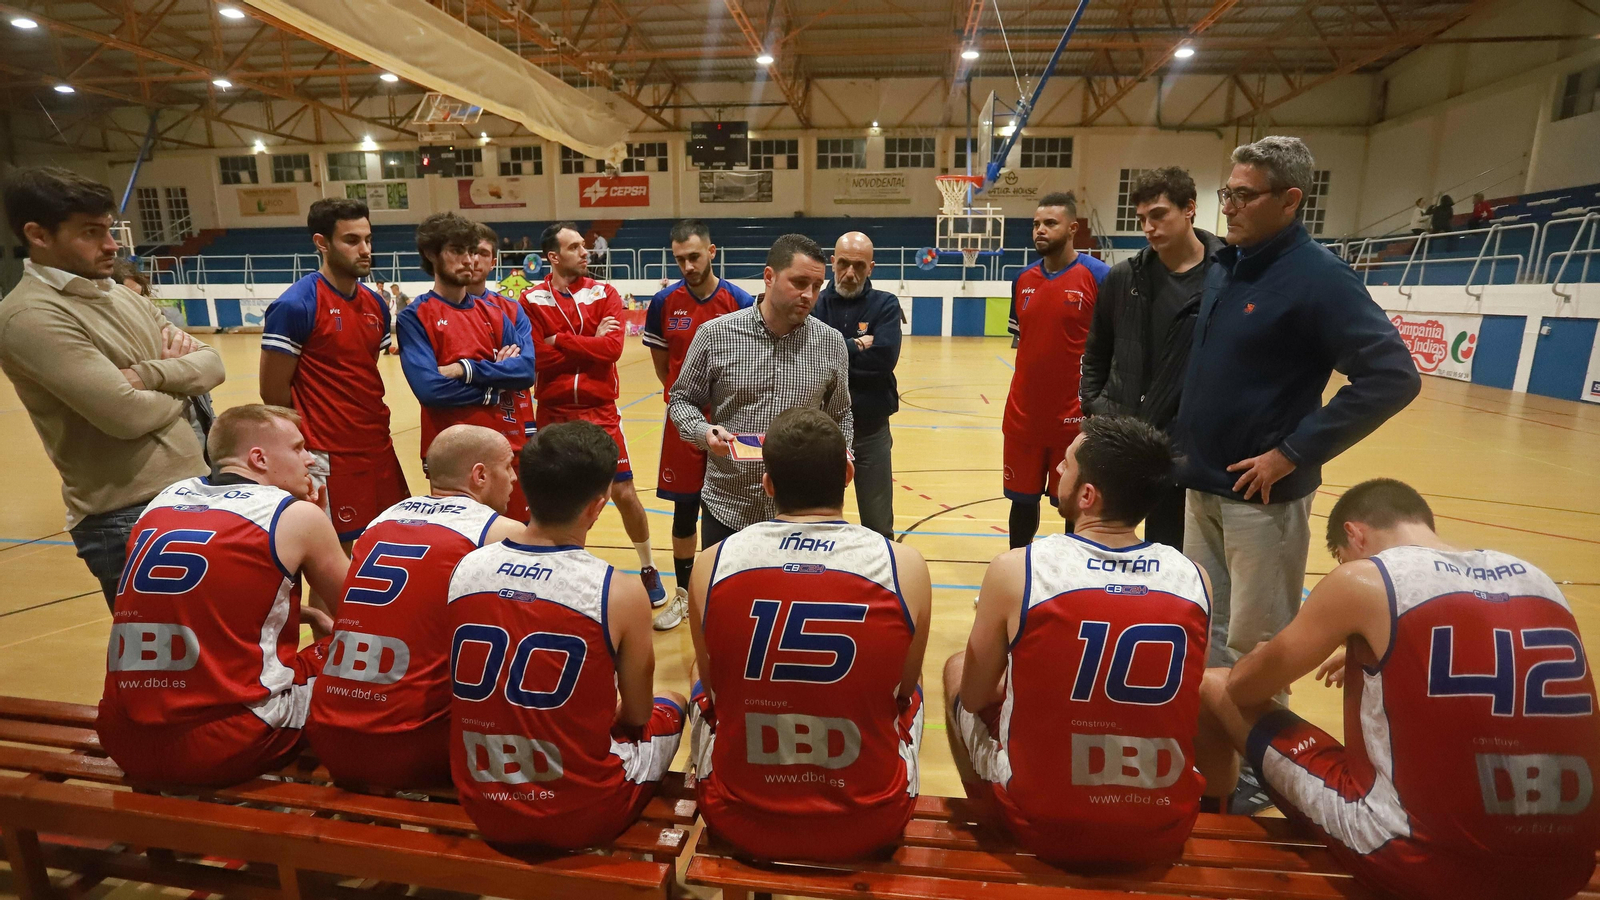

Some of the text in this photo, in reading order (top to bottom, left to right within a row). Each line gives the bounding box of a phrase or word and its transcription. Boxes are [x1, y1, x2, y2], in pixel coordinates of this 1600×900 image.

[609, 185, 647, 197] CEPSA
[851, 177, 906, 188] NOVODENTAL
[667, 316, 693, 331] 33
[116, 527, 217, 597] 16
[778, 531, 836, 552] IÑAKI
[1086, 555, 1161, 573] COTÁN
[343, 540, 432, 607] 5
[496, 562, 554, 581] ADÁN
[107, 622, 201, 672] DBD
[321, 629, 411, 685] DBD
[450, 622, 589, 711] 00
[743, 598, 870, 685] 15
[1069, 620, 1189, 707] 10
[117, 677, 187, 689] ww.dbd.es
[325, 684, 388, 702] www.dbd.es
[1426, 625, 1594, 718] 42
[462, 730, 564, 785] DBD
[744, 711, 862, 770] DBD
[1070, 732, 1186, 790] DBD
[764, 771, 846, 788] www.dbd.es
[1088, 793, 1171, 806] www.dbd.es
[1474, 752, 1594, 816] DBD
